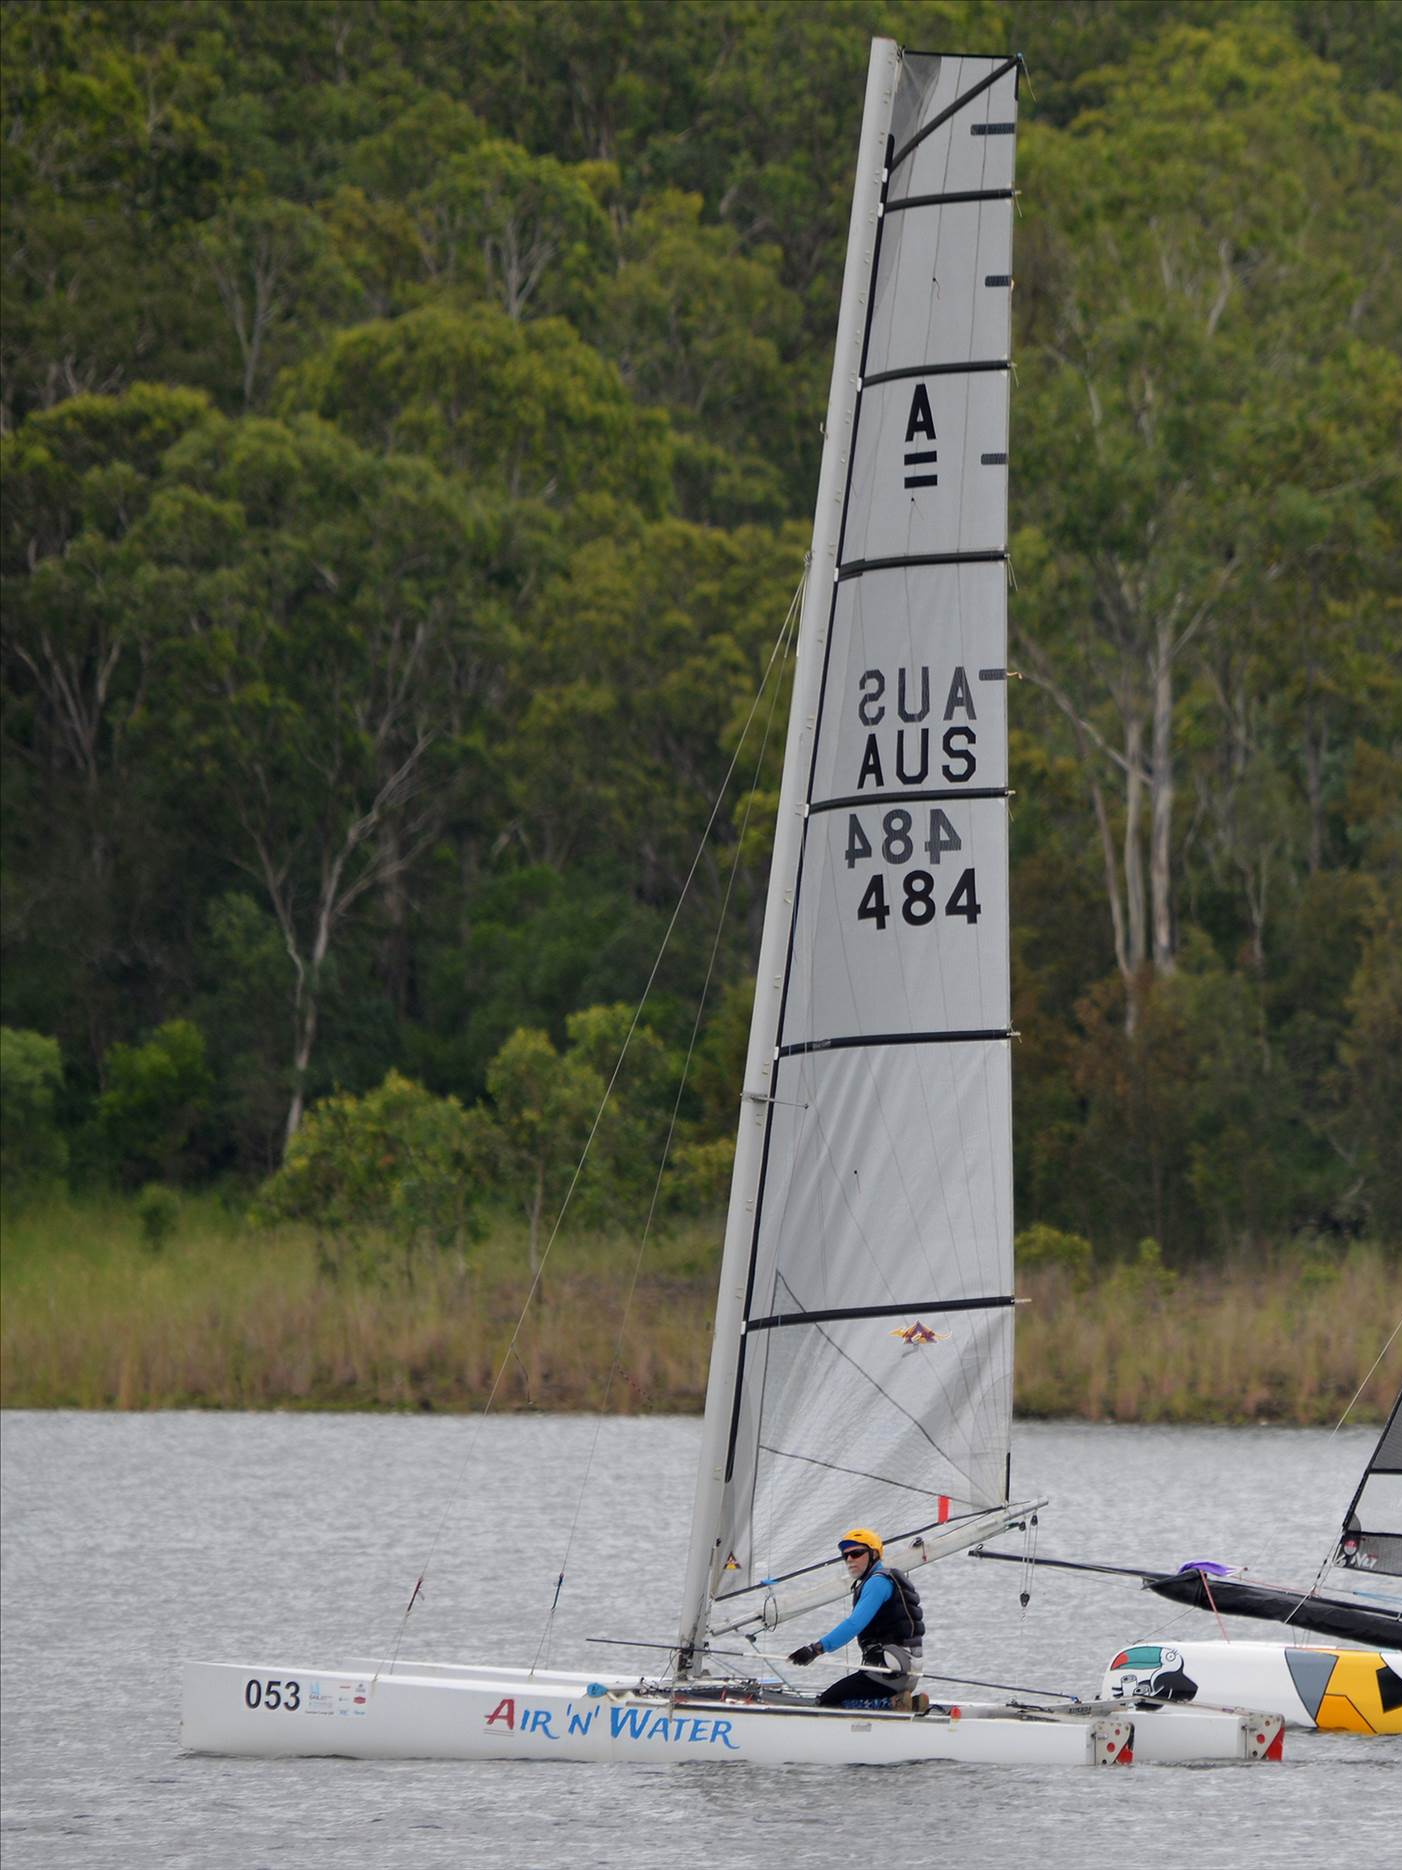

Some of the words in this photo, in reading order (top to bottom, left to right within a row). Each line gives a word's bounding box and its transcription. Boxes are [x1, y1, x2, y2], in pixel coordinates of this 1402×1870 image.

[905, 384, 936, 442] A
[857, 726, 976, 790] AUS
[857, 869, 981, 930] 484
[245, 1679, 301, 1711] 053
